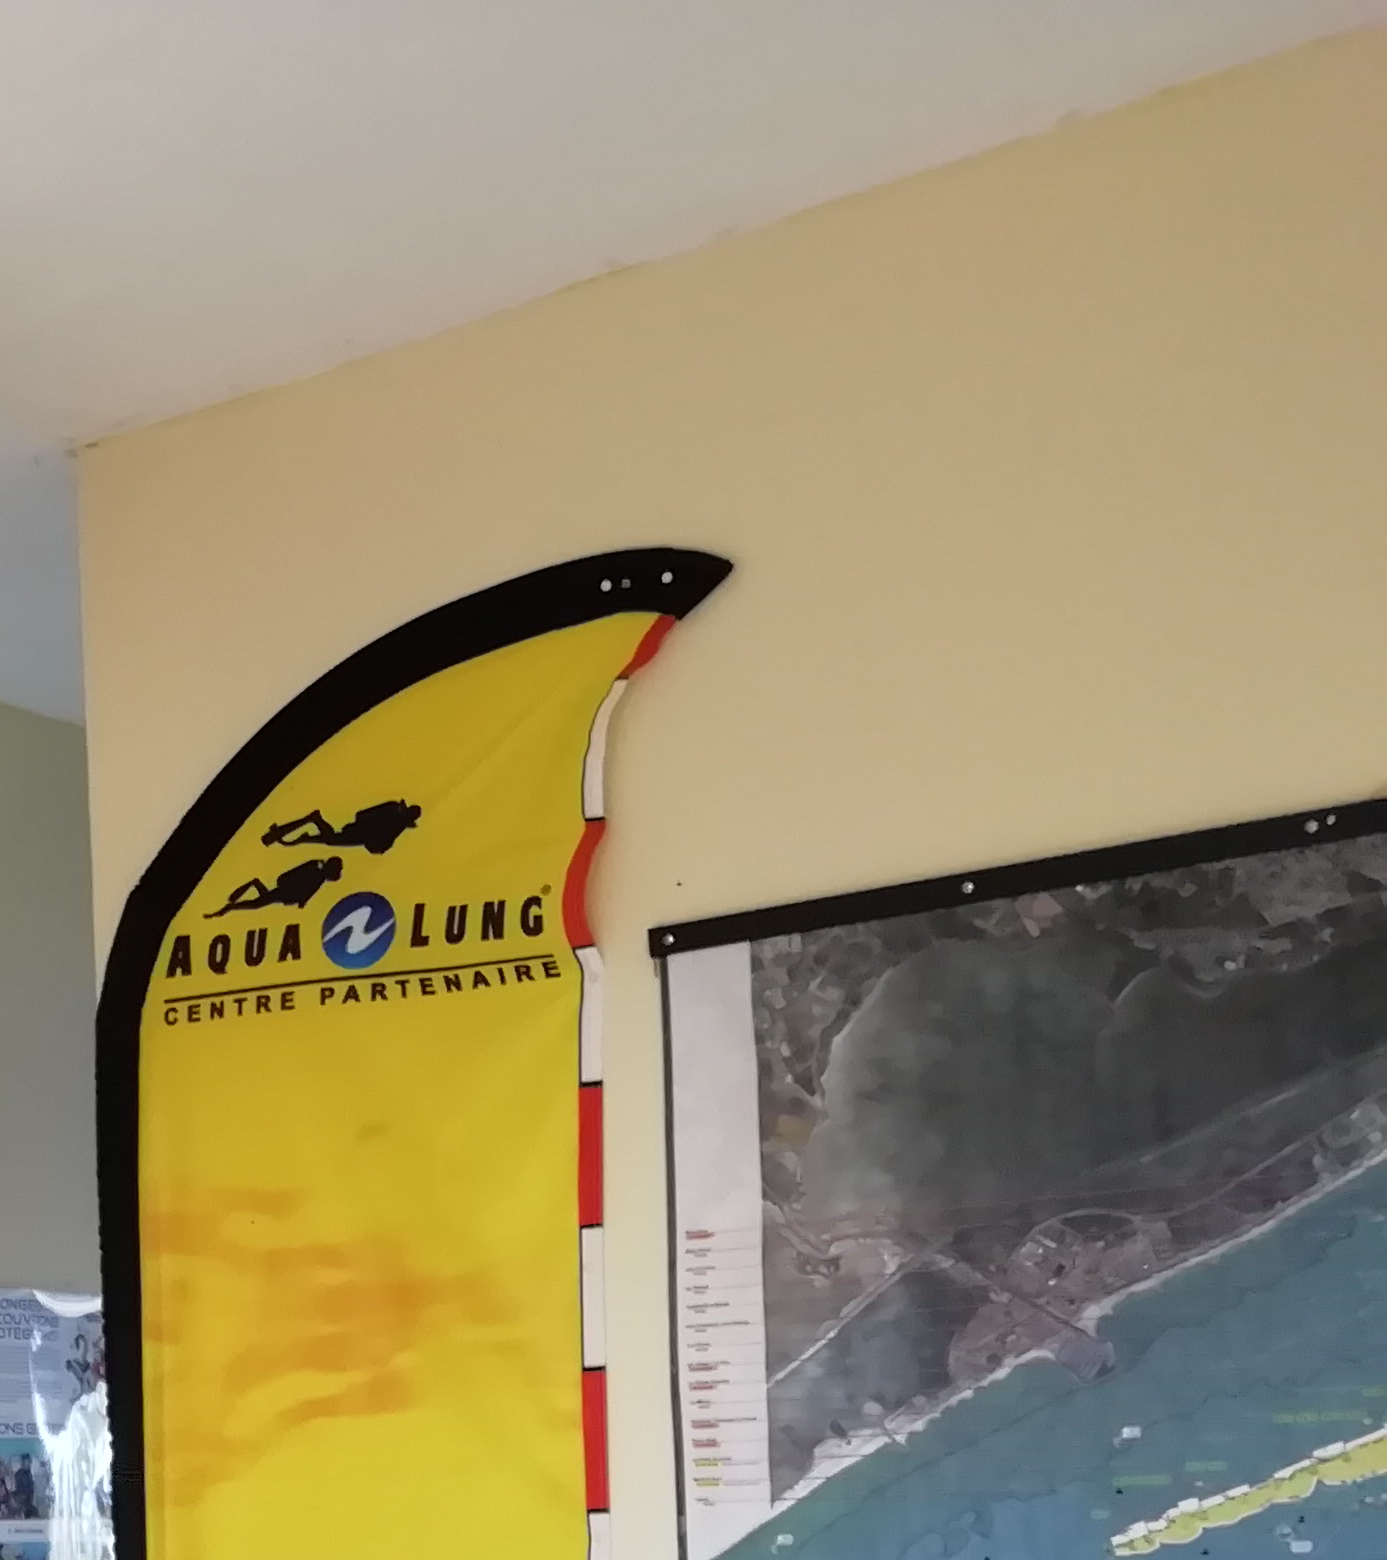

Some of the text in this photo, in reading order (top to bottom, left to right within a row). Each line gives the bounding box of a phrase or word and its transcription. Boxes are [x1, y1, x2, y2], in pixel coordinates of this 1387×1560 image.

[165, 894, 545, 979] AQUA LUNG
[163, 959, 562, 1027] CENTRE PARTENAIRE
